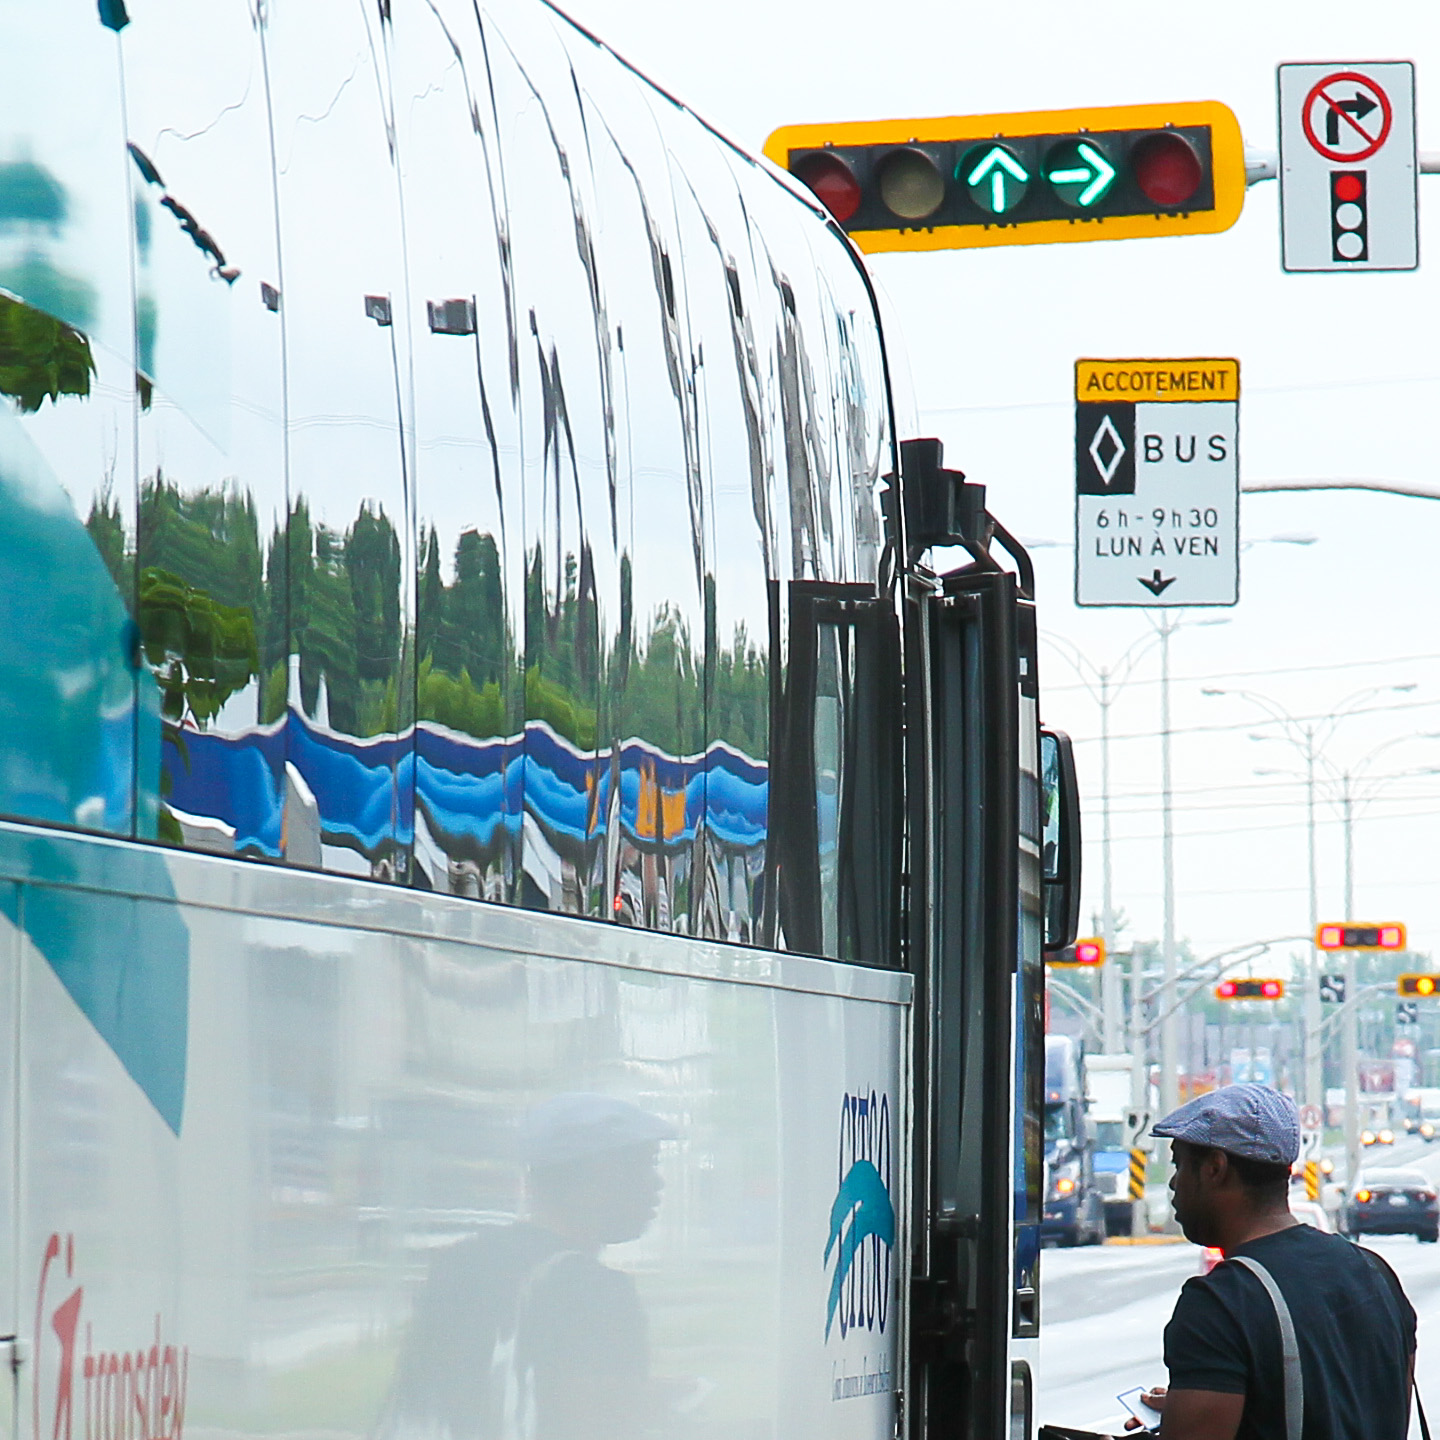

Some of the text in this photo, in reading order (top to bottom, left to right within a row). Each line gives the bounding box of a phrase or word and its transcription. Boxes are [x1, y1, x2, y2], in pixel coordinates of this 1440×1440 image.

[1086, 370, 1229, 392] ACCOTEMENT
[1143, 433, 1228, 464] BUS
[1096, 529, 1219, 557] LUN À VEN
